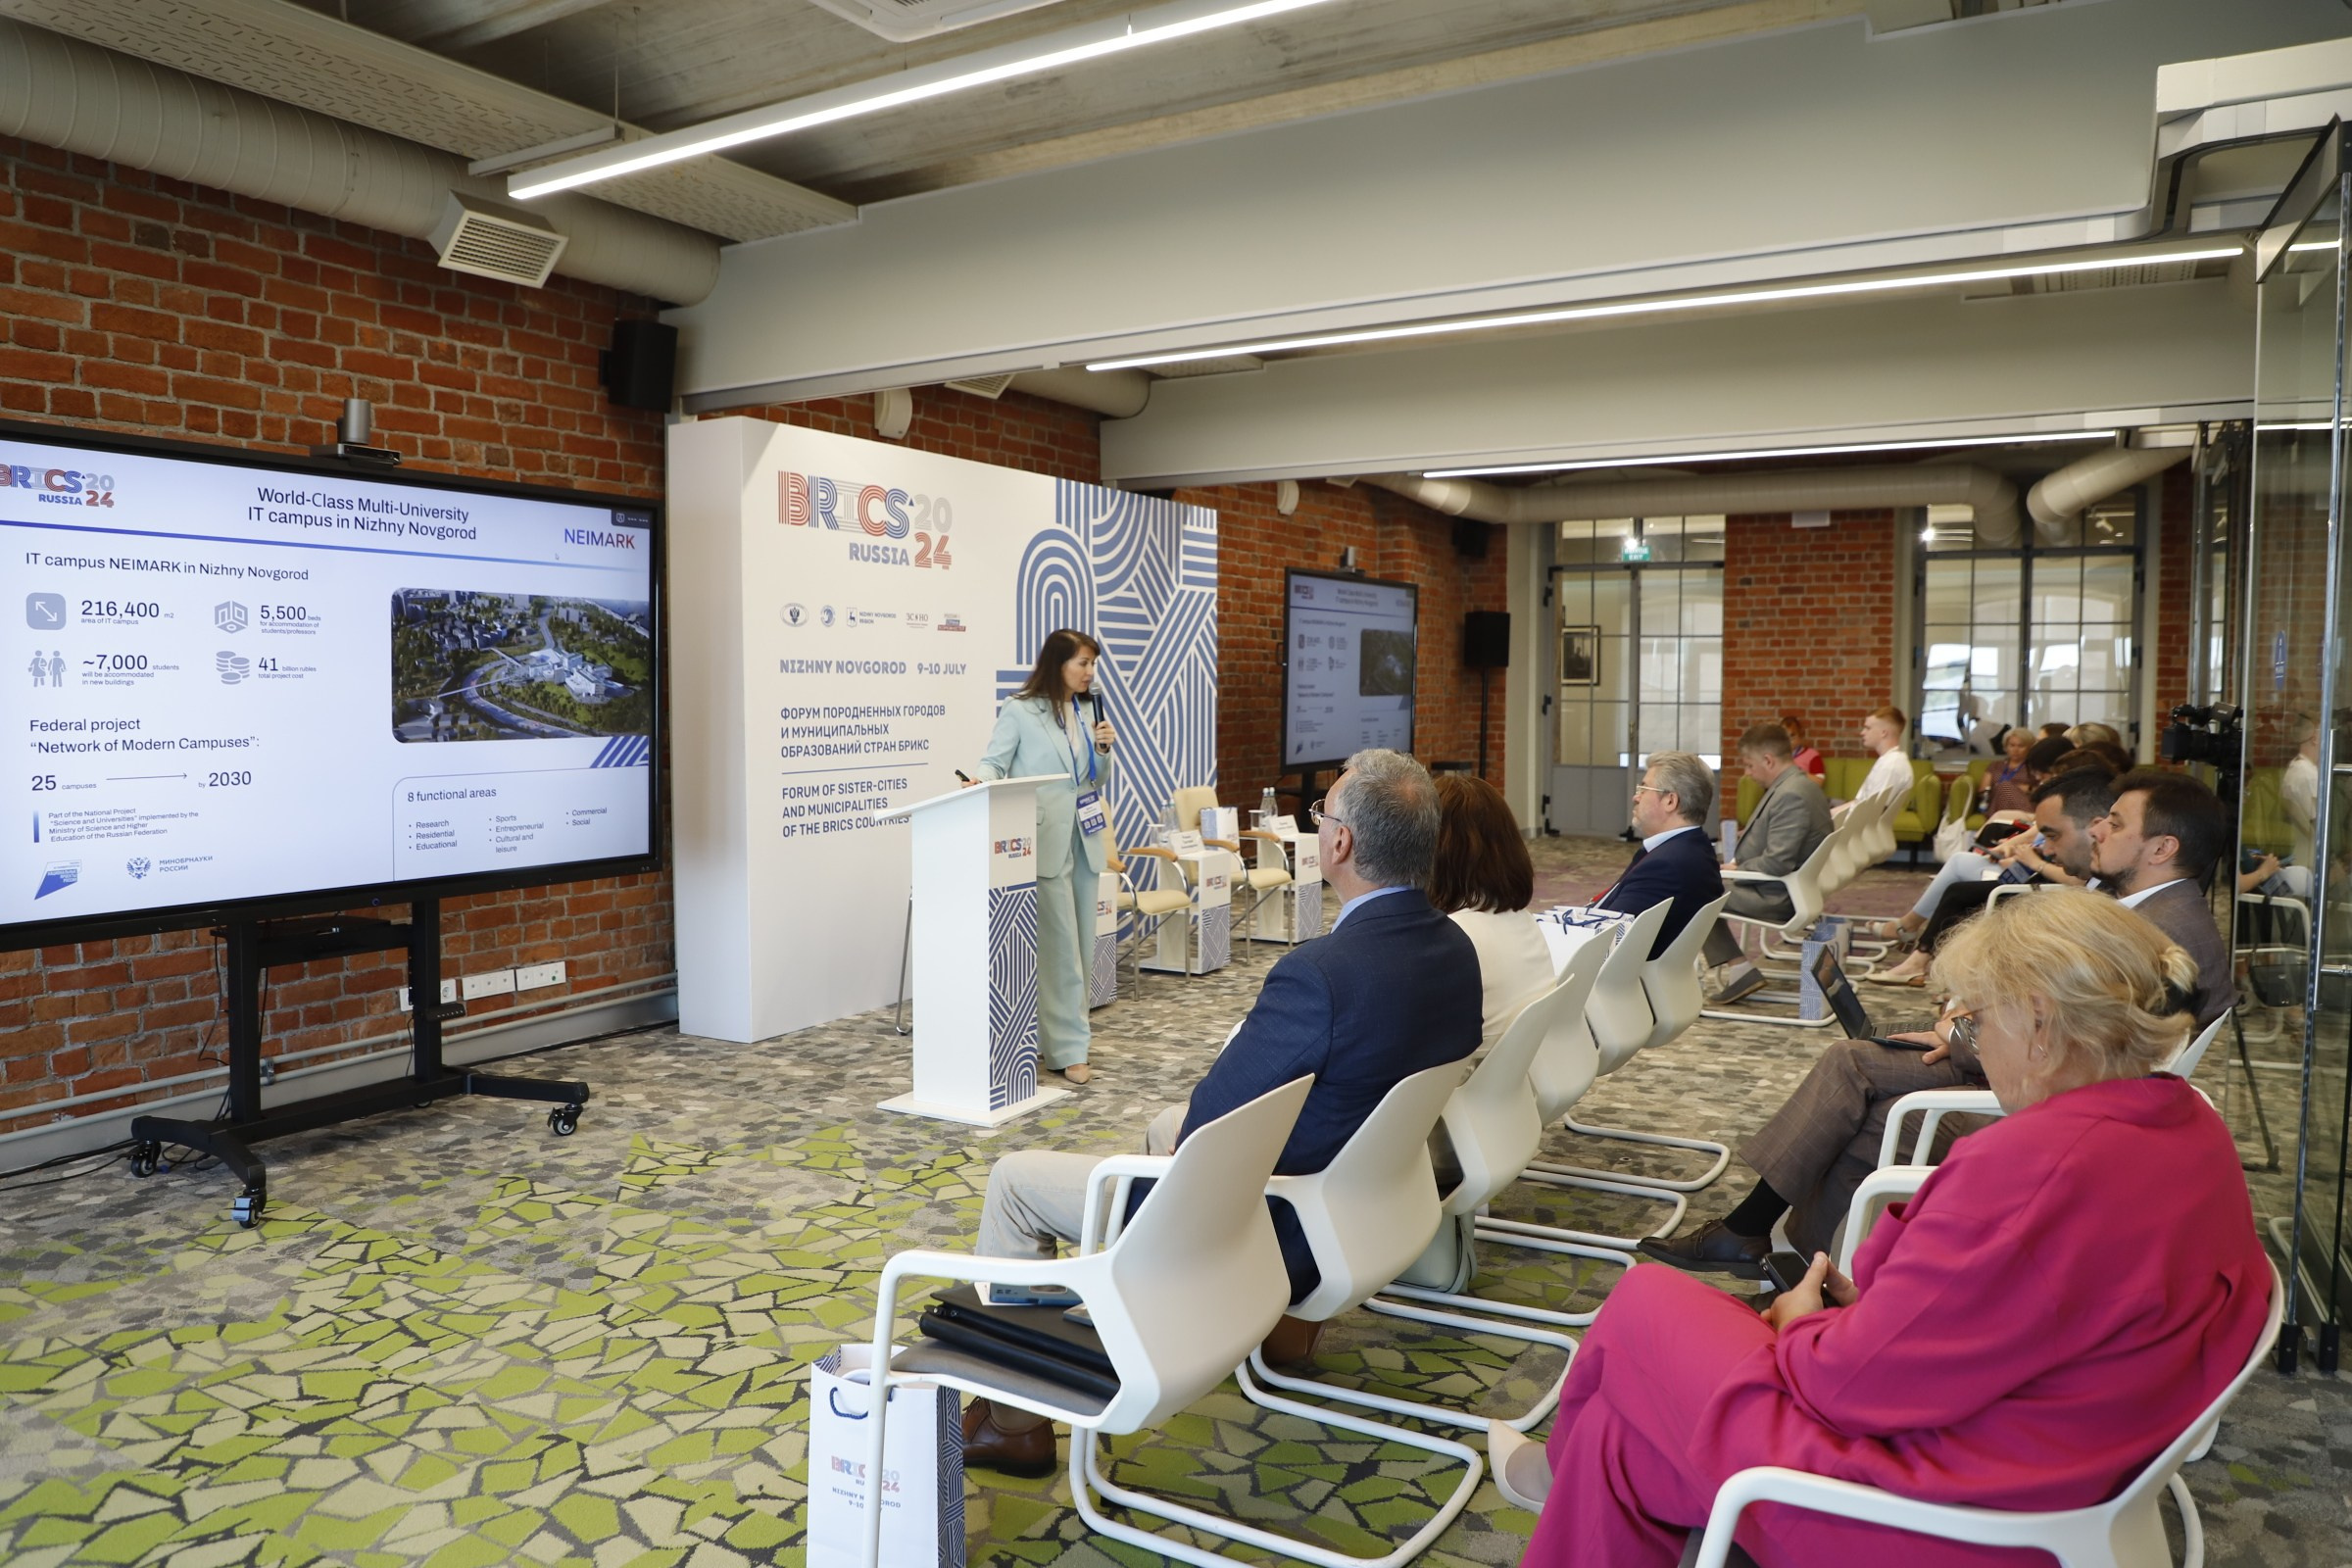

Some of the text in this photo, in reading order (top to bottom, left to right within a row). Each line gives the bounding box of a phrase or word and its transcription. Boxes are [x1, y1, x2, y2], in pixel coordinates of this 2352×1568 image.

[38, 490, 115, 508] RUSSIA 24
[258, 487, 468, 524] World-Class Multi-University
[777, 470, 910, 539] BRICS
[249, 507, 476, 540] IT campus in Nizhny Novgorod
[564, 528, 635, 550] NEIMARK
[849, 531, 953, 570] RUSSIA 24
[25, 552, 309, 581] IT campus NEIMARK in Nizhny Novgorod
[81, 600, 160, 618] 216,400
[261, 605, 306, 621] 5,500
[83, 654, 148, 672] ~7,000
[259, 657, 278, 671] 41
[779, 660, 833, 674] NIZHNY
[836, 661, 906, 674] NOVGOROD
[943, 663, 966, 675] JULY
[781, 705, 946, 720] ФОРУМ ПОРОДНЕННЫХ ГОРОДОВ
[29, 718, 141, 734] Federal project
[781, 723, 890, 740] И МУНИЦИПАЛЬНЫХ
[104, 739, 119, 752] of
[122, 737, 175, 752] Modern
[781, 739, 930, 758] ОБРАЗОВАНИЙ СТРАН БРИКС
[31, 775, 97, 791] 25 campuses
[209, 771, 252, 787] 2030
[408, 788, 497, 802] 8 functional areas
[782, 778, 907, 800] FORUM OF SISTER-CITIES
[113, 808, 136, 816] Project
[571, 807, 608, 816] Commercial
[782, 797, 888, 819] AND MUNICIPALITIES
[139, 812, 179, 822] implemented
[416, 819, 449, 829] Research
[495, 814, 517, 824] Sports
[571, 817, 590, 826] Social
[49, 826, 75, 836] Ministry
[126, 821, 148, 831] Higher
[416, 829, 455, 840] Residential
[495, 822, 545, 833] Entrepreneurial
[782, 825, 797, 838] OF
[800, 822, 820, 835] THE
[822, 818, 854, 833] BRICS
[50, 834, 85, 843] Education
[106, 830, 133, 839] Russian
[133, 828, 168, 837] Federation
[495, 833, 534, 844] Cultural and
[416, 840, 458, 851] Educational
[495, 845, 517, 854] leisure
[159, 856, 214, 865] МИНОБРНАУКИ
[831, 1455, 865, 1479] BRIC
[832, 1486, 858, 1499] NIZHNY
